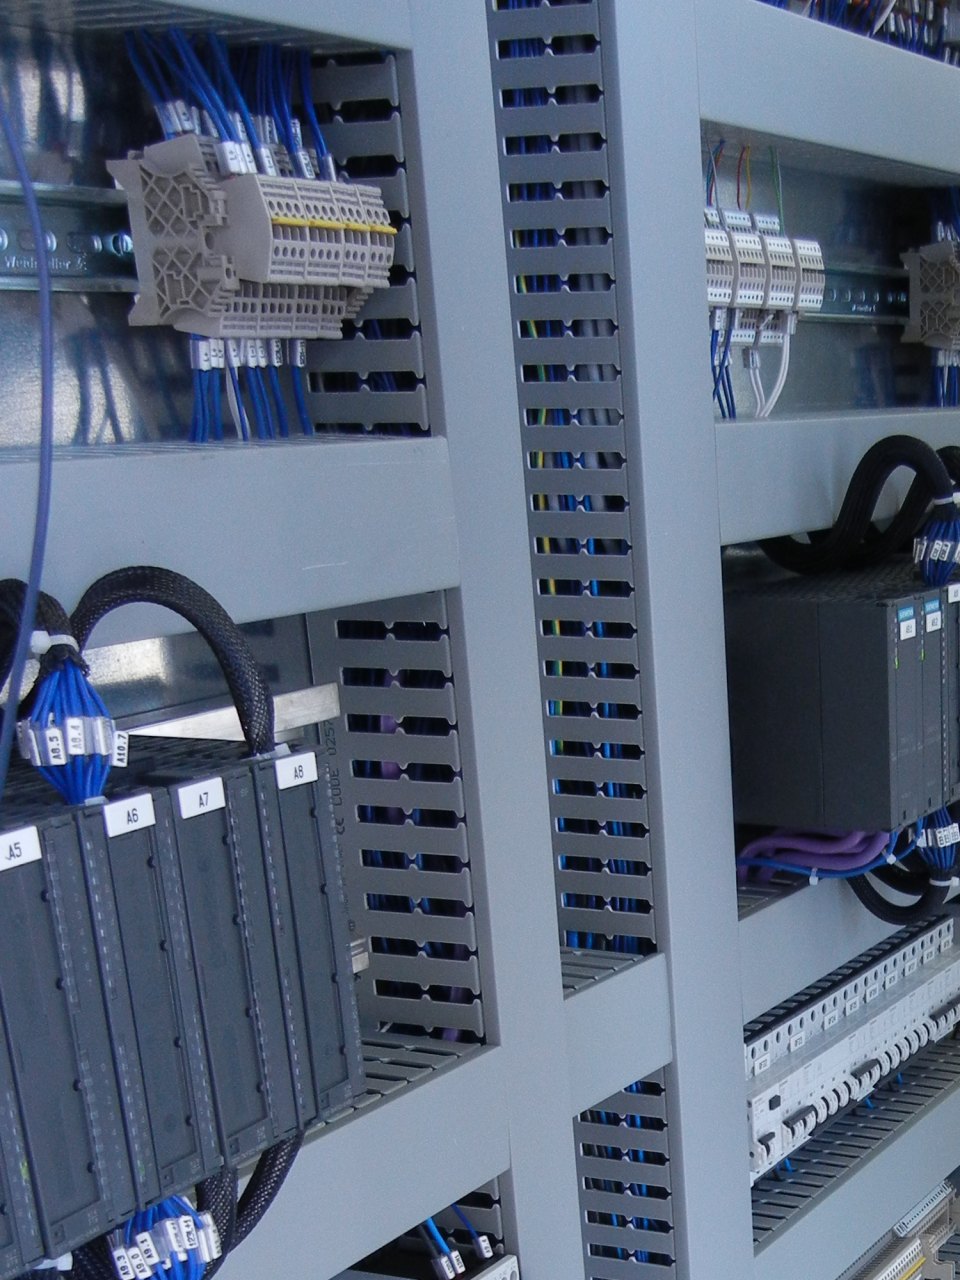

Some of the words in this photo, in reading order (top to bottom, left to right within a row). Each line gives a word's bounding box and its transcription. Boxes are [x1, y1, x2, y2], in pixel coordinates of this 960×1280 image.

[198, 792, 210, 808] A7
[126, 808, 139, 825] A6
[8, 842, 22, 858] A5
